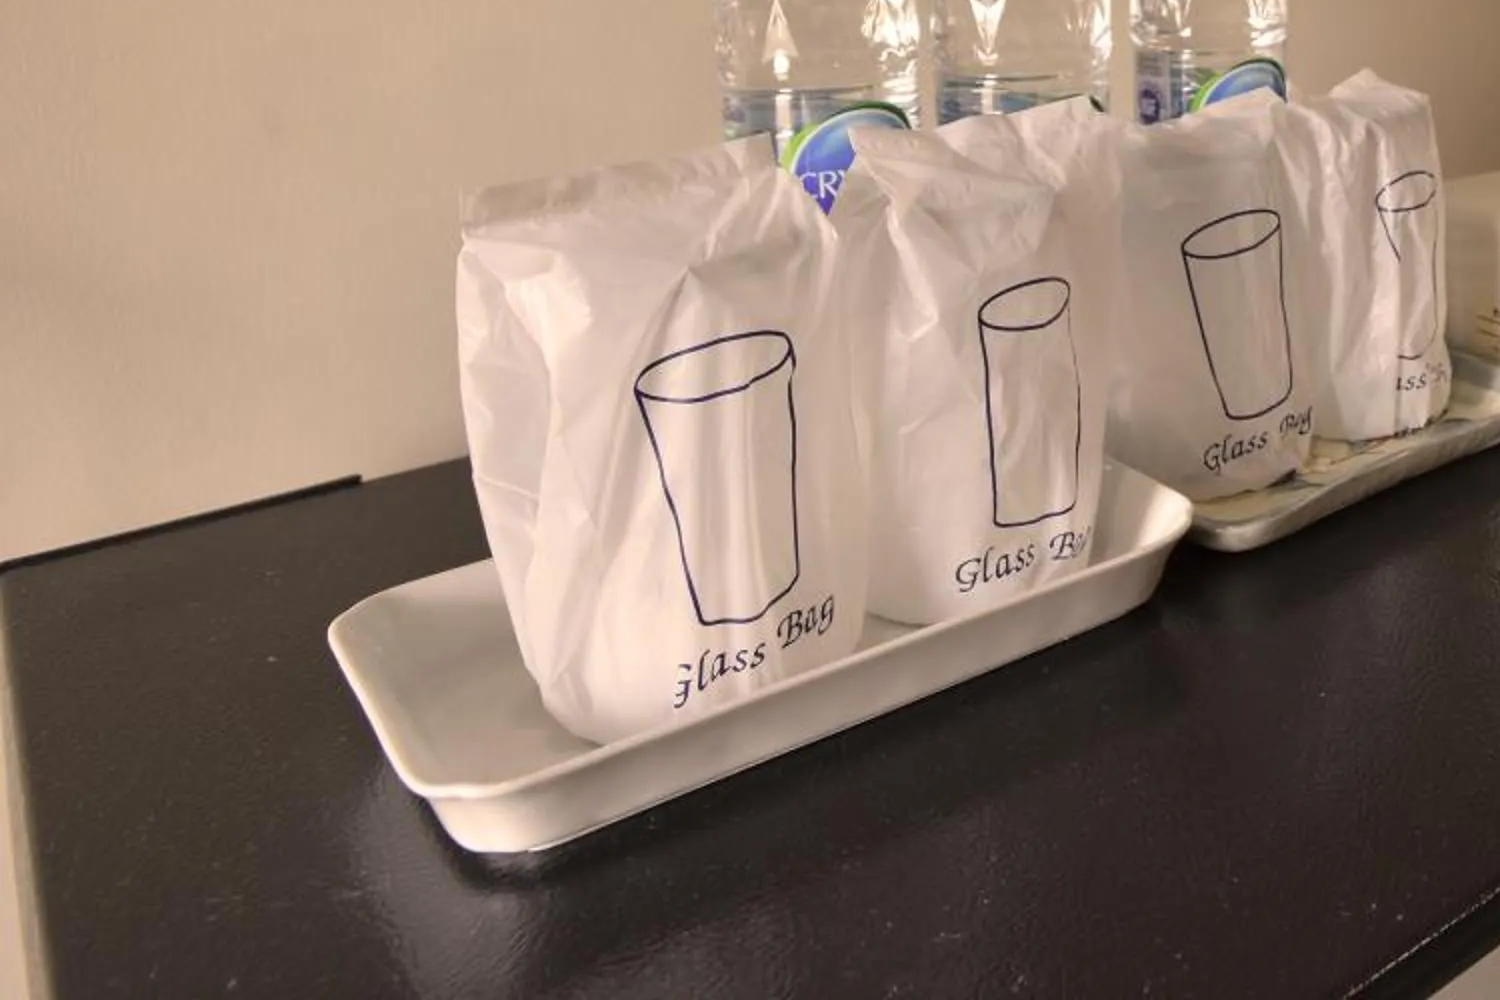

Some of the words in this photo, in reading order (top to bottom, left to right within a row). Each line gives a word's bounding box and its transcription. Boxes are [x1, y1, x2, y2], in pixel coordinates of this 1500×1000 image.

[800, 168, 845, 199] CR
[1203, 431, 1269, 476] Glass
[954, 543, 1036, 593] Glass
[776, 594, 835, 649] Bag
